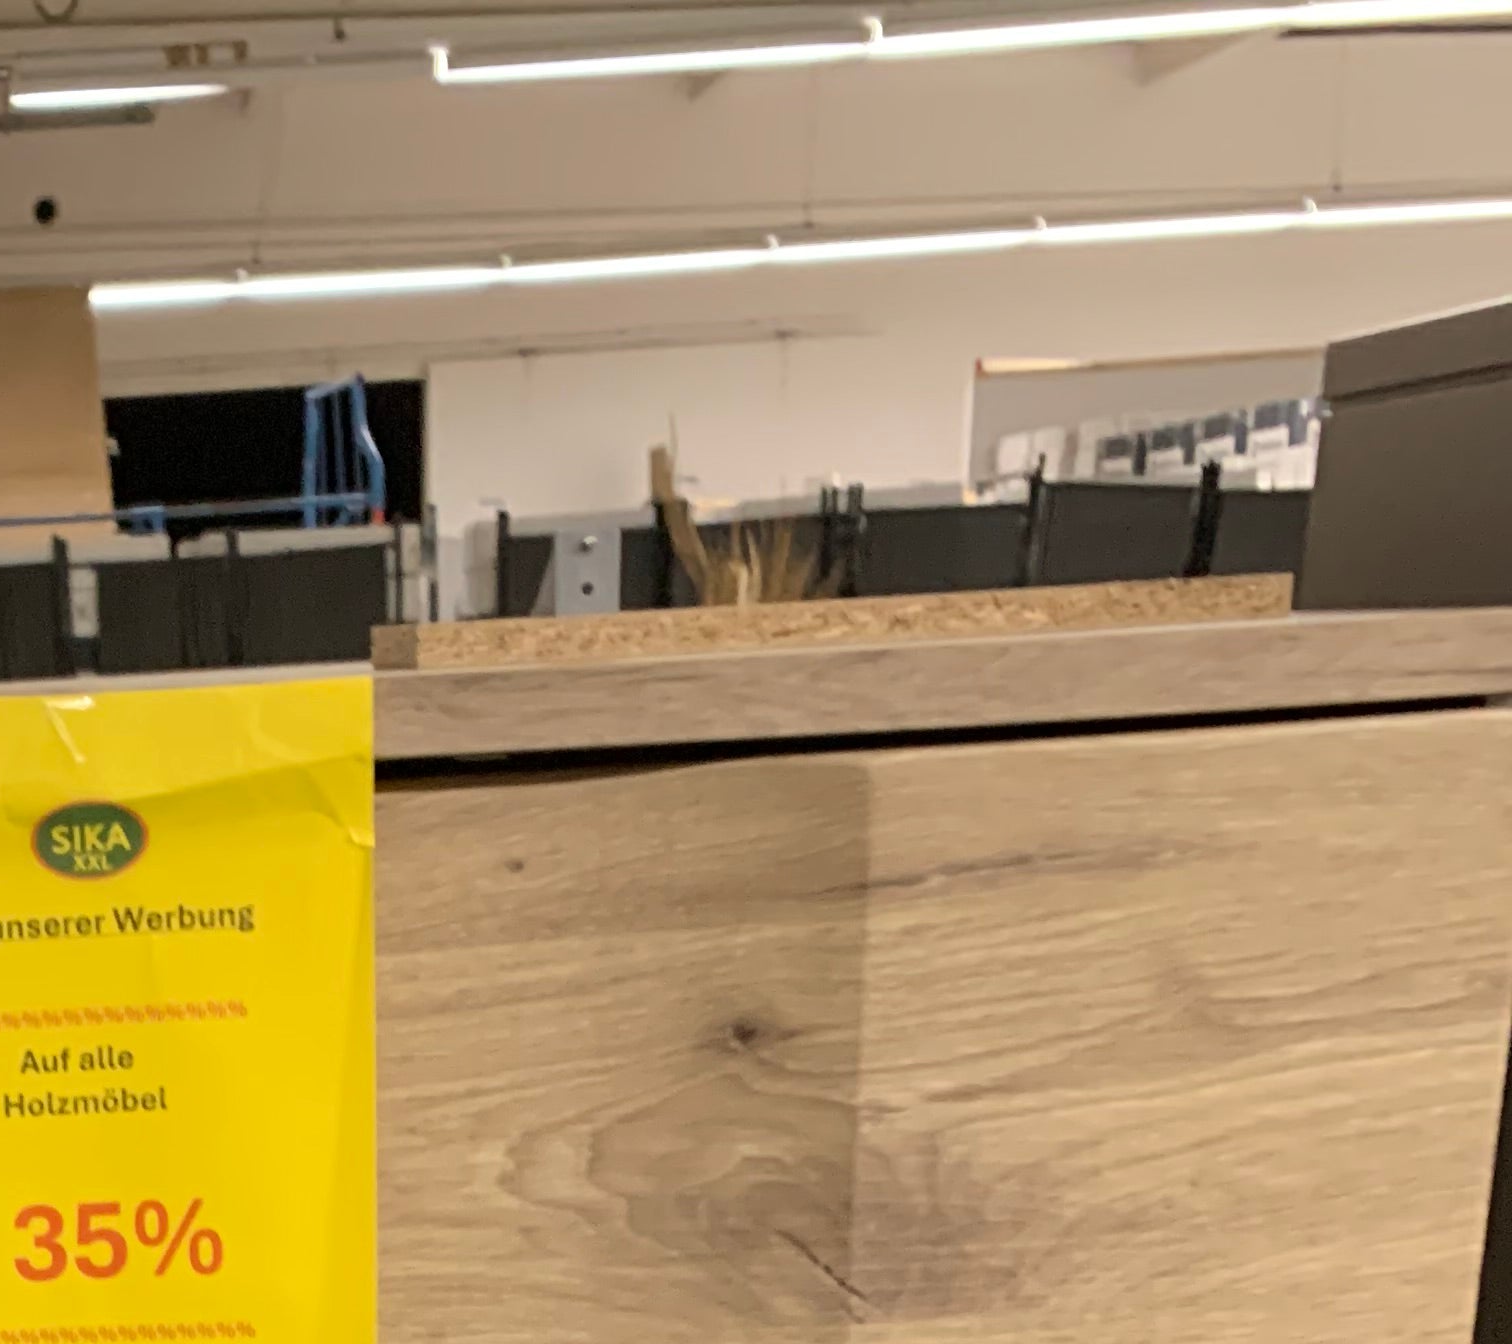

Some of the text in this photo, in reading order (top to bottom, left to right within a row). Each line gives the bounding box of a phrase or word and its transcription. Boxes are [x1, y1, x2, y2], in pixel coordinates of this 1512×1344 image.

[51, 822, 131, 855] SIKA
[74, 853, 112, 872] XXL
[111, 904, 255, 933] Werbung
[20, 1045, 135, 1074] Auf alle
[2, 1086, 168, 1118] Holzmöbel
[14, 1198, 223, 1281] 35%
